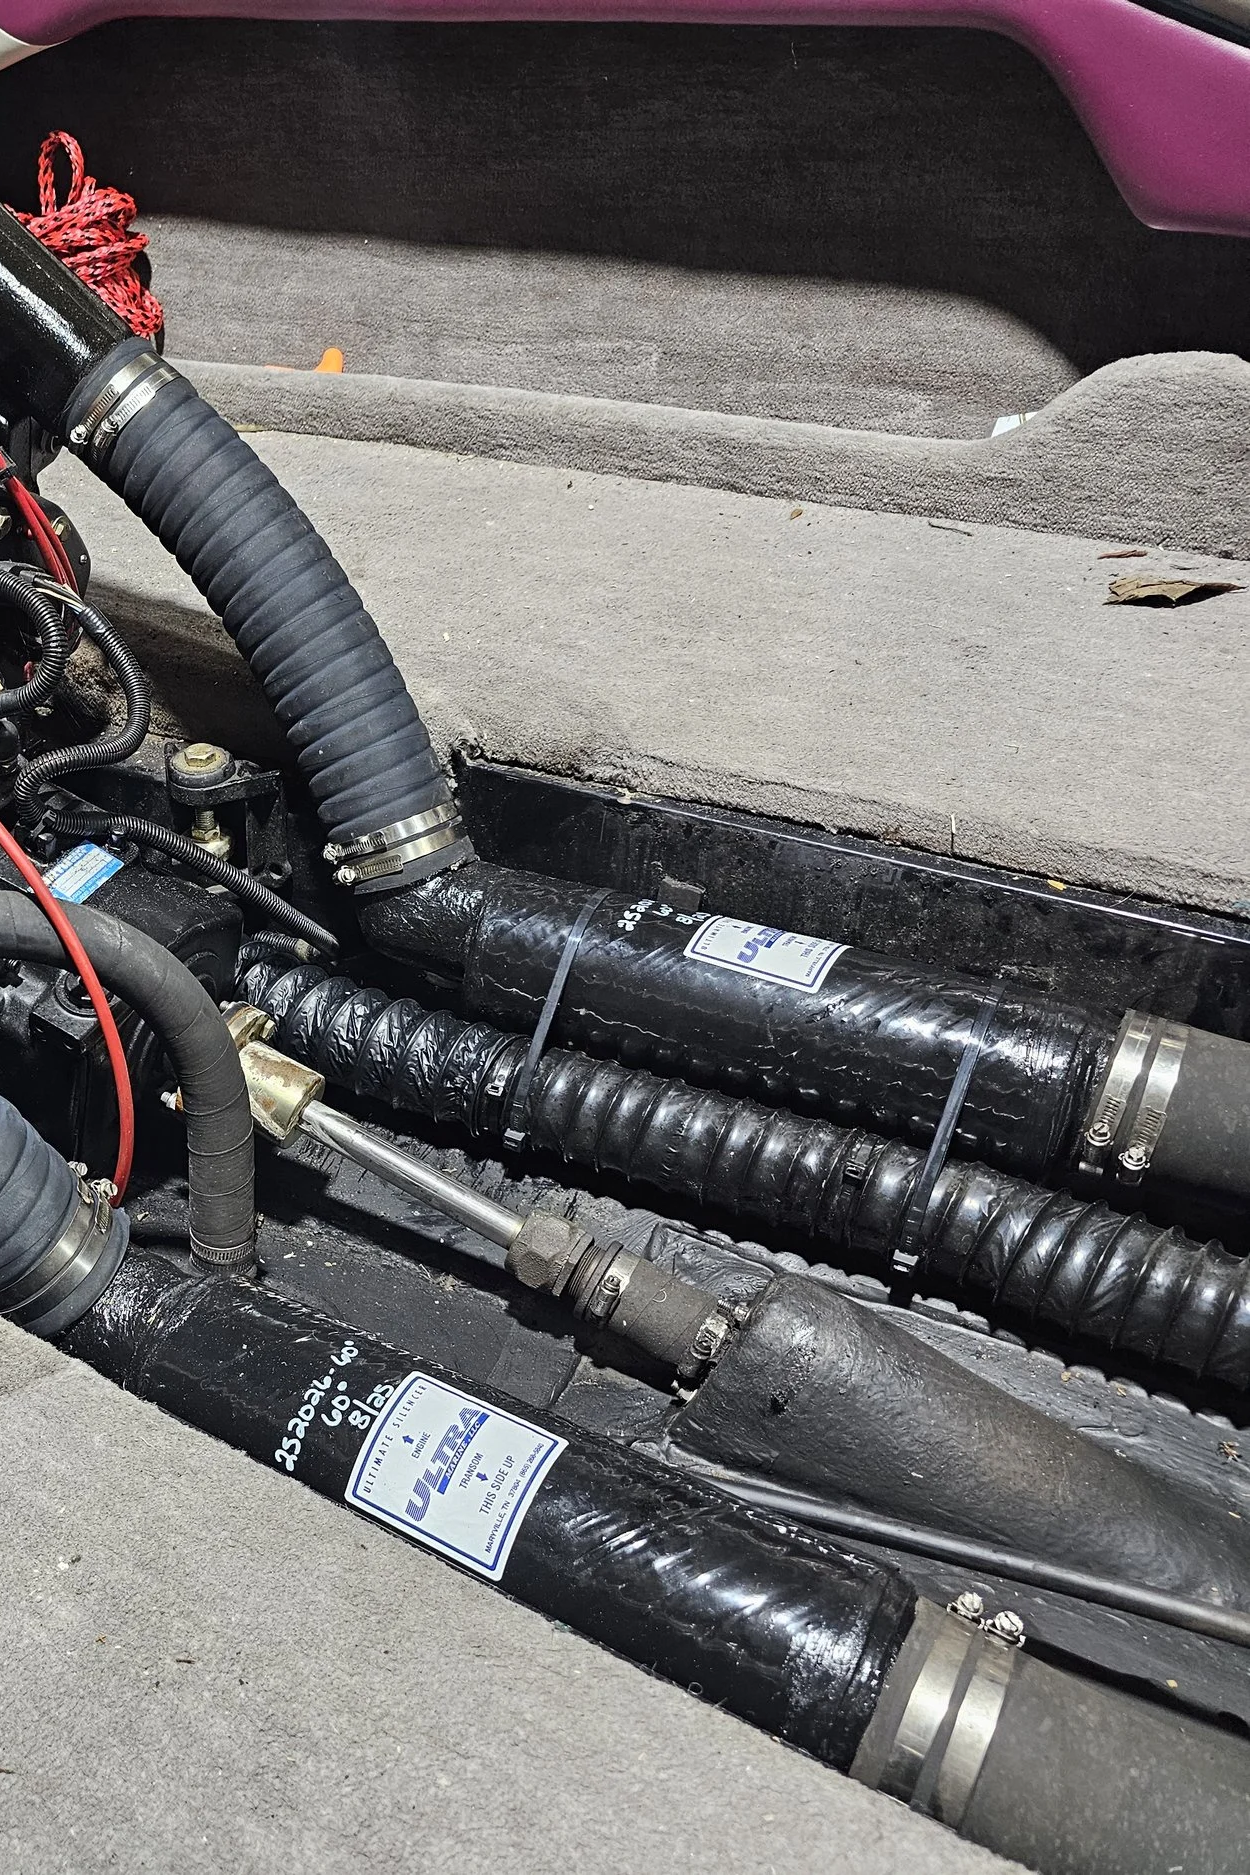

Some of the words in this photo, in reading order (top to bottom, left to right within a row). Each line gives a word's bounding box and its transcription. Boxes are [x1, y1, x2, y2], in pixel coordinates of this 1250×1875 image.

[362, 1434, 393, 1493] ULTIMATE
[392, 1383, 427, 1427] SILENCER
[411, 1431, 430, 1459] ENGINE
[468, 1420, 480, 1437] LLC
[404, 1407, 479, 1522] ULTRA
[458, 1452, 483, 1489] TRANSOM
[479, 1490, 496, 1514] THIS
[490, 1467, 509, 1491] SIDE
[503, 1454, 516, 1468] UP
[501, 1500, 510, 1510] TN
